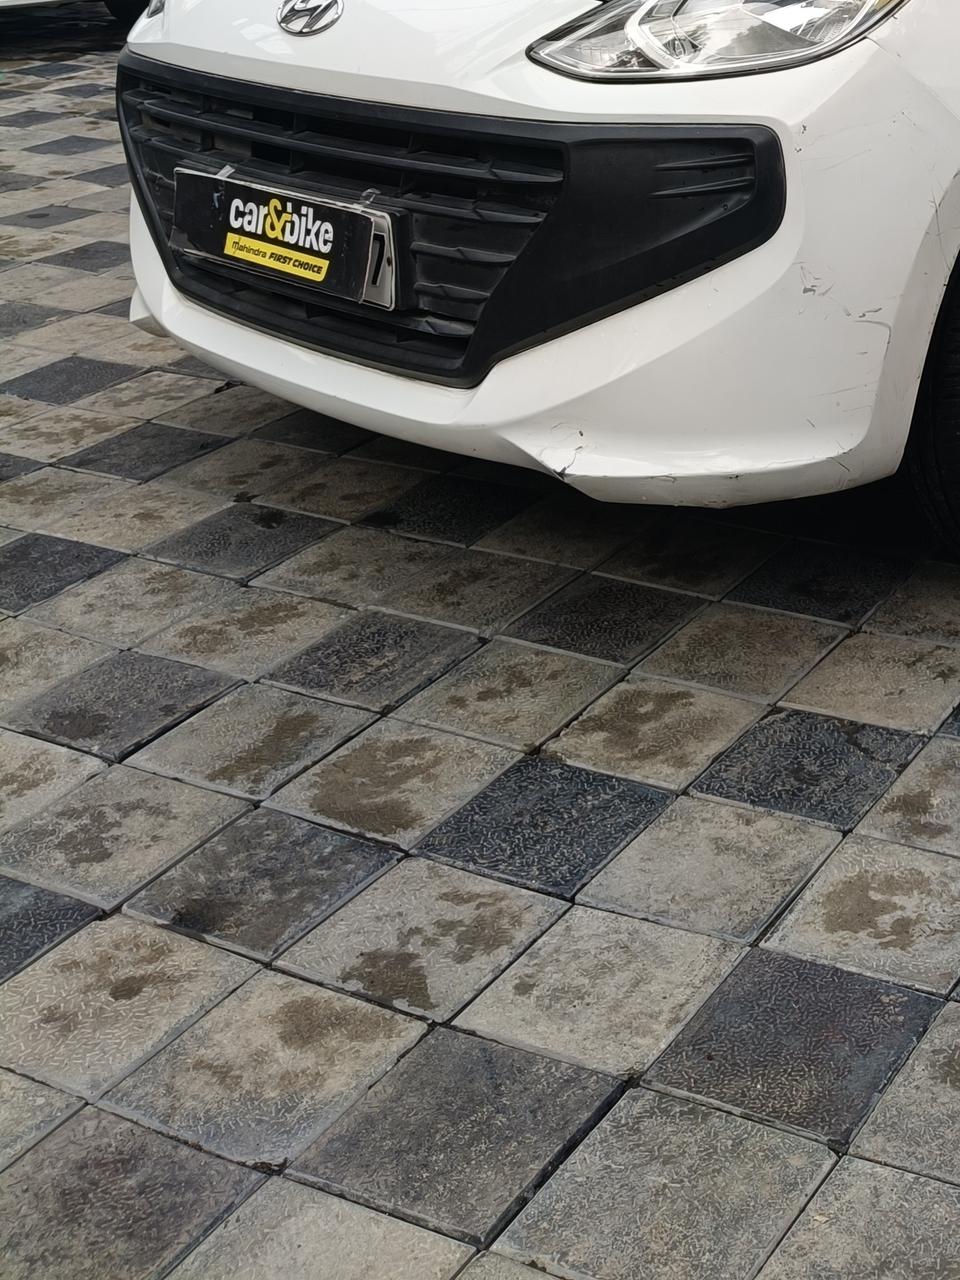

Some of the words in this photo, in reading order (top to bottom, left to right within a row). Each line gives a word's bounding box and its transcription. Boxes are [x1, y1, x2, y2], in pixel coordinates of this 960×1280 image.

[229, 198, 334, 254] car&bike
[232, 240, 267, 258] Mahindra
[268, 252, 293, 265] FIRST
[292, 259, 324, 274] CHOICE
